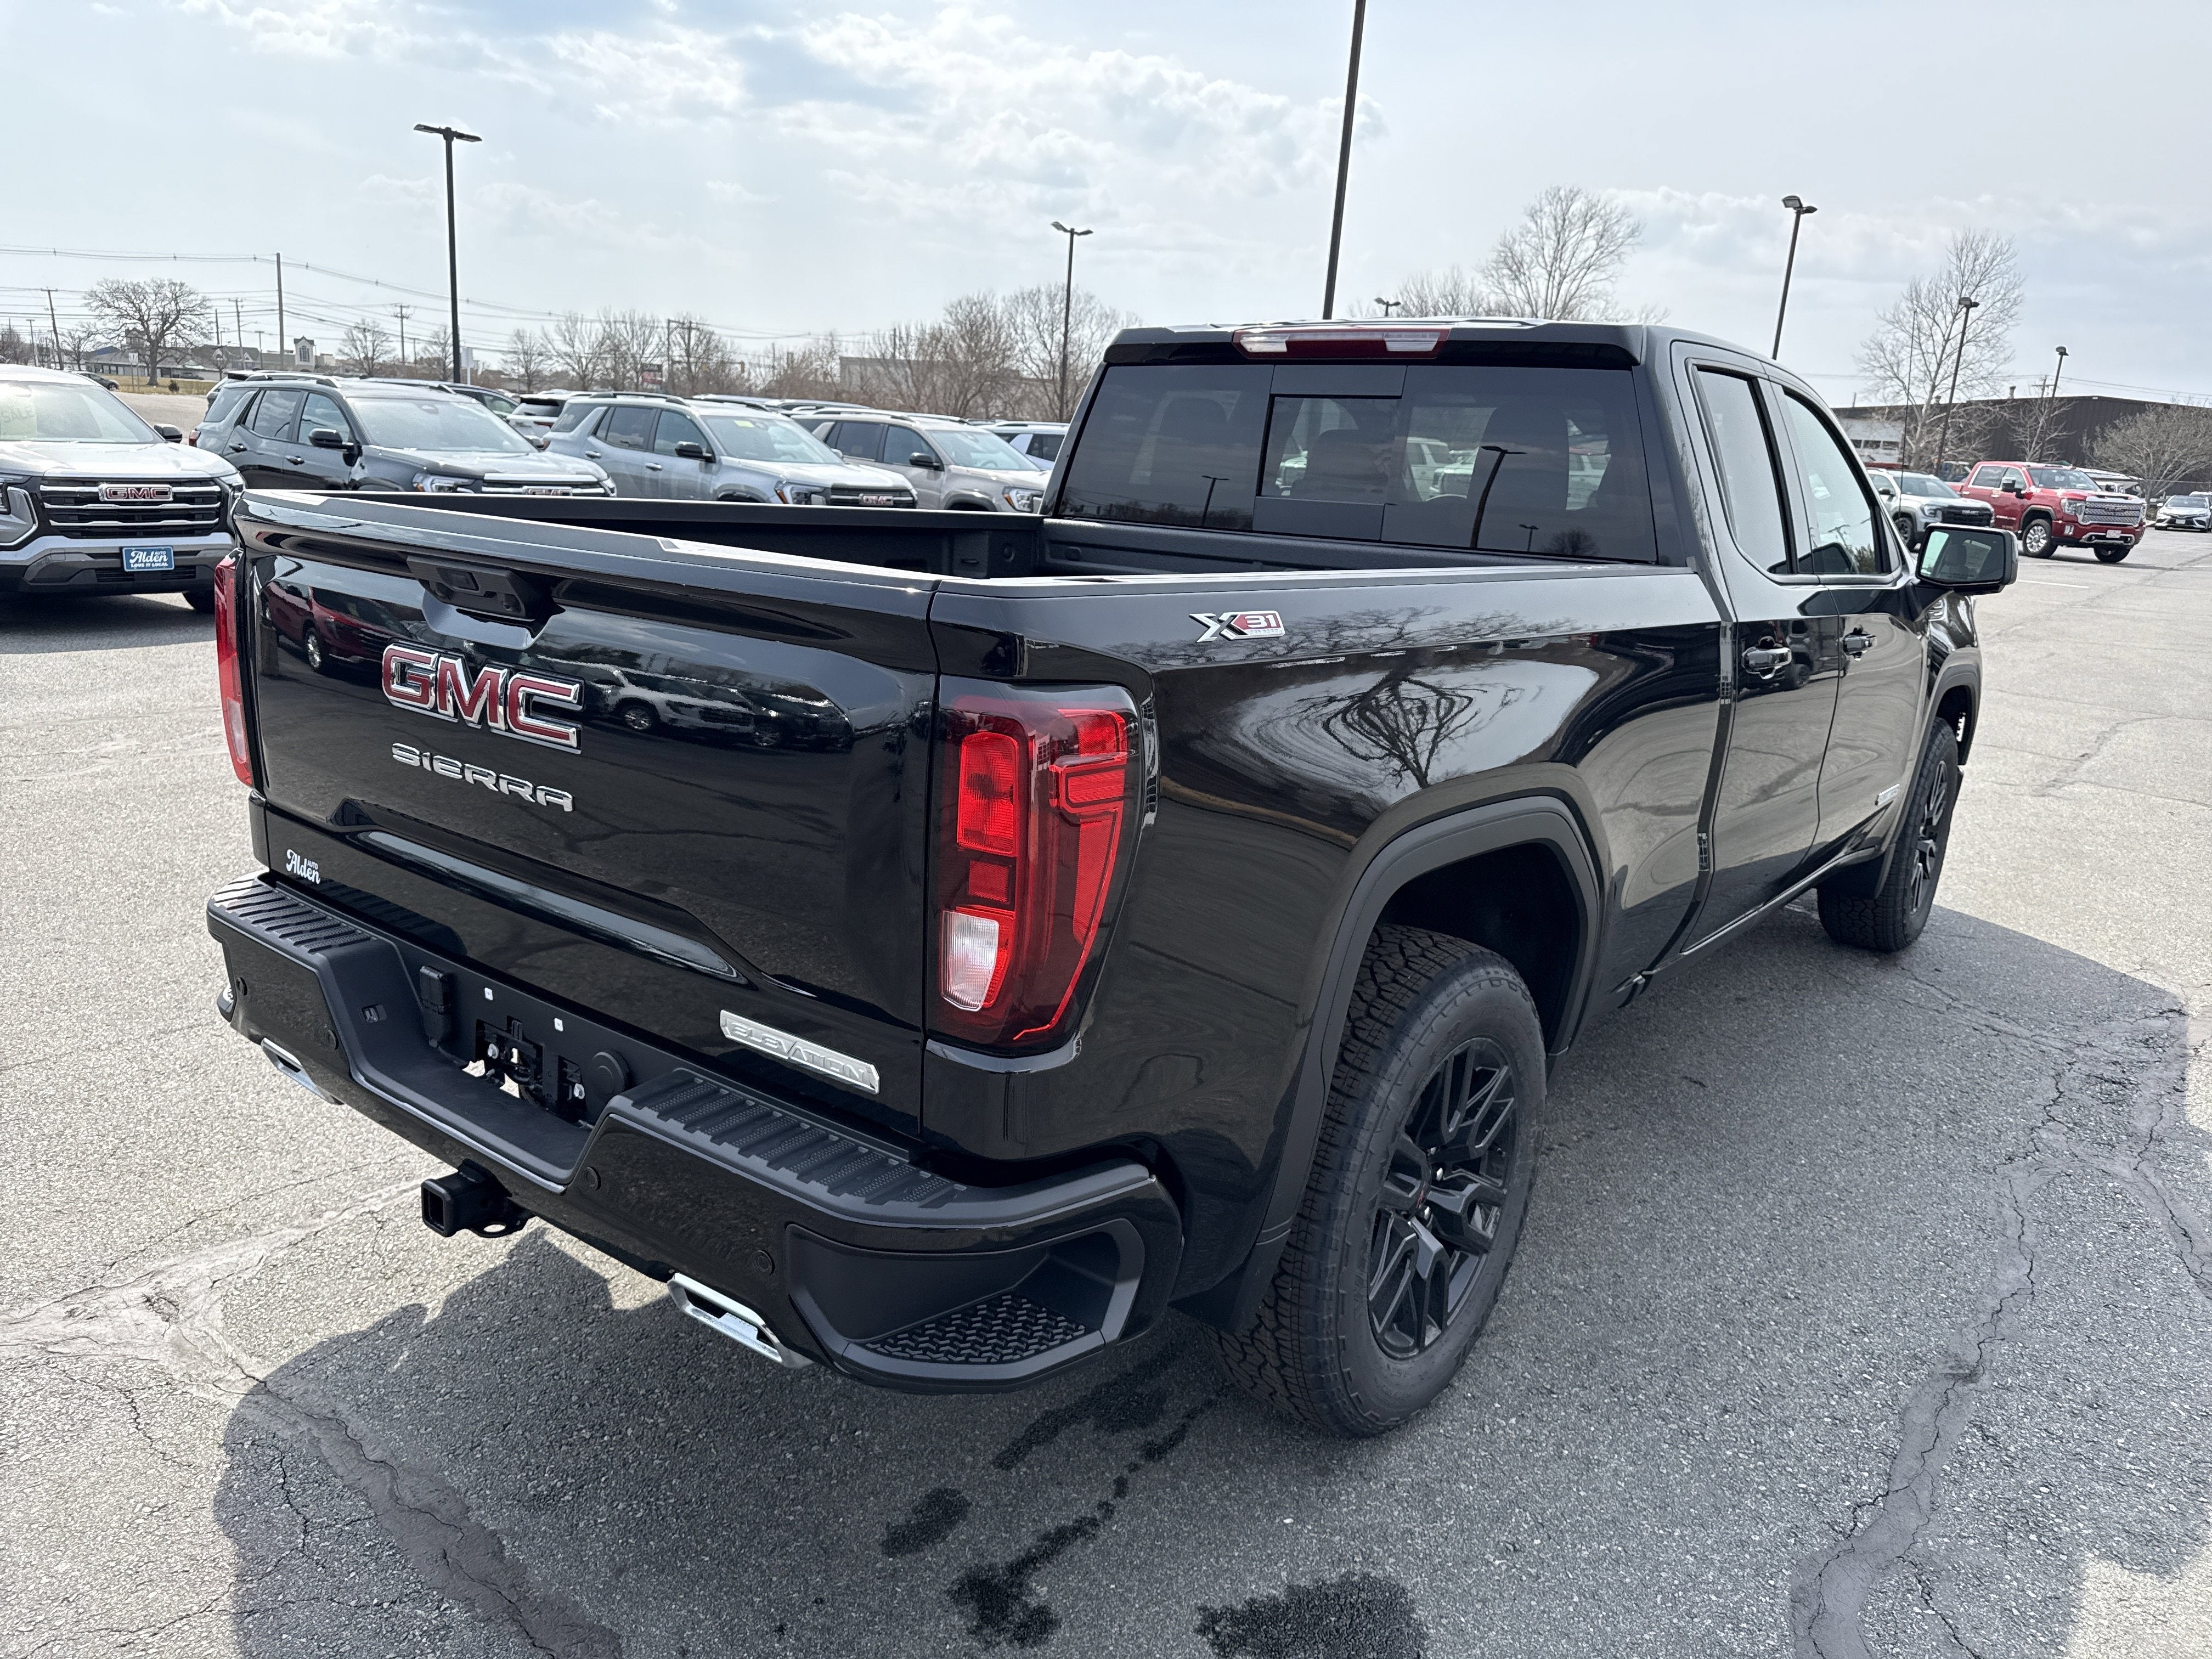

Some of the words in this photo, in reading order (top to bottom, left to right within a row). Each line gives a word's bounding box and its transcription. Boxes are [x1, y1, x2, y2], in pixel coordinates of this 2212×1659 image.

[106, 487, 171, 500] GMC
[129, 550, 169, 563] Alden
[1189, 611, 1285, 642] X31
[382, 642, 584, 754] GMC
[392, 743, 575, 812] SIERRA
[286, 849, 320, 884] Alden
[307, 860, 318, 870] AUTO
[731, 1022, 865, 1081] ELEVATION
